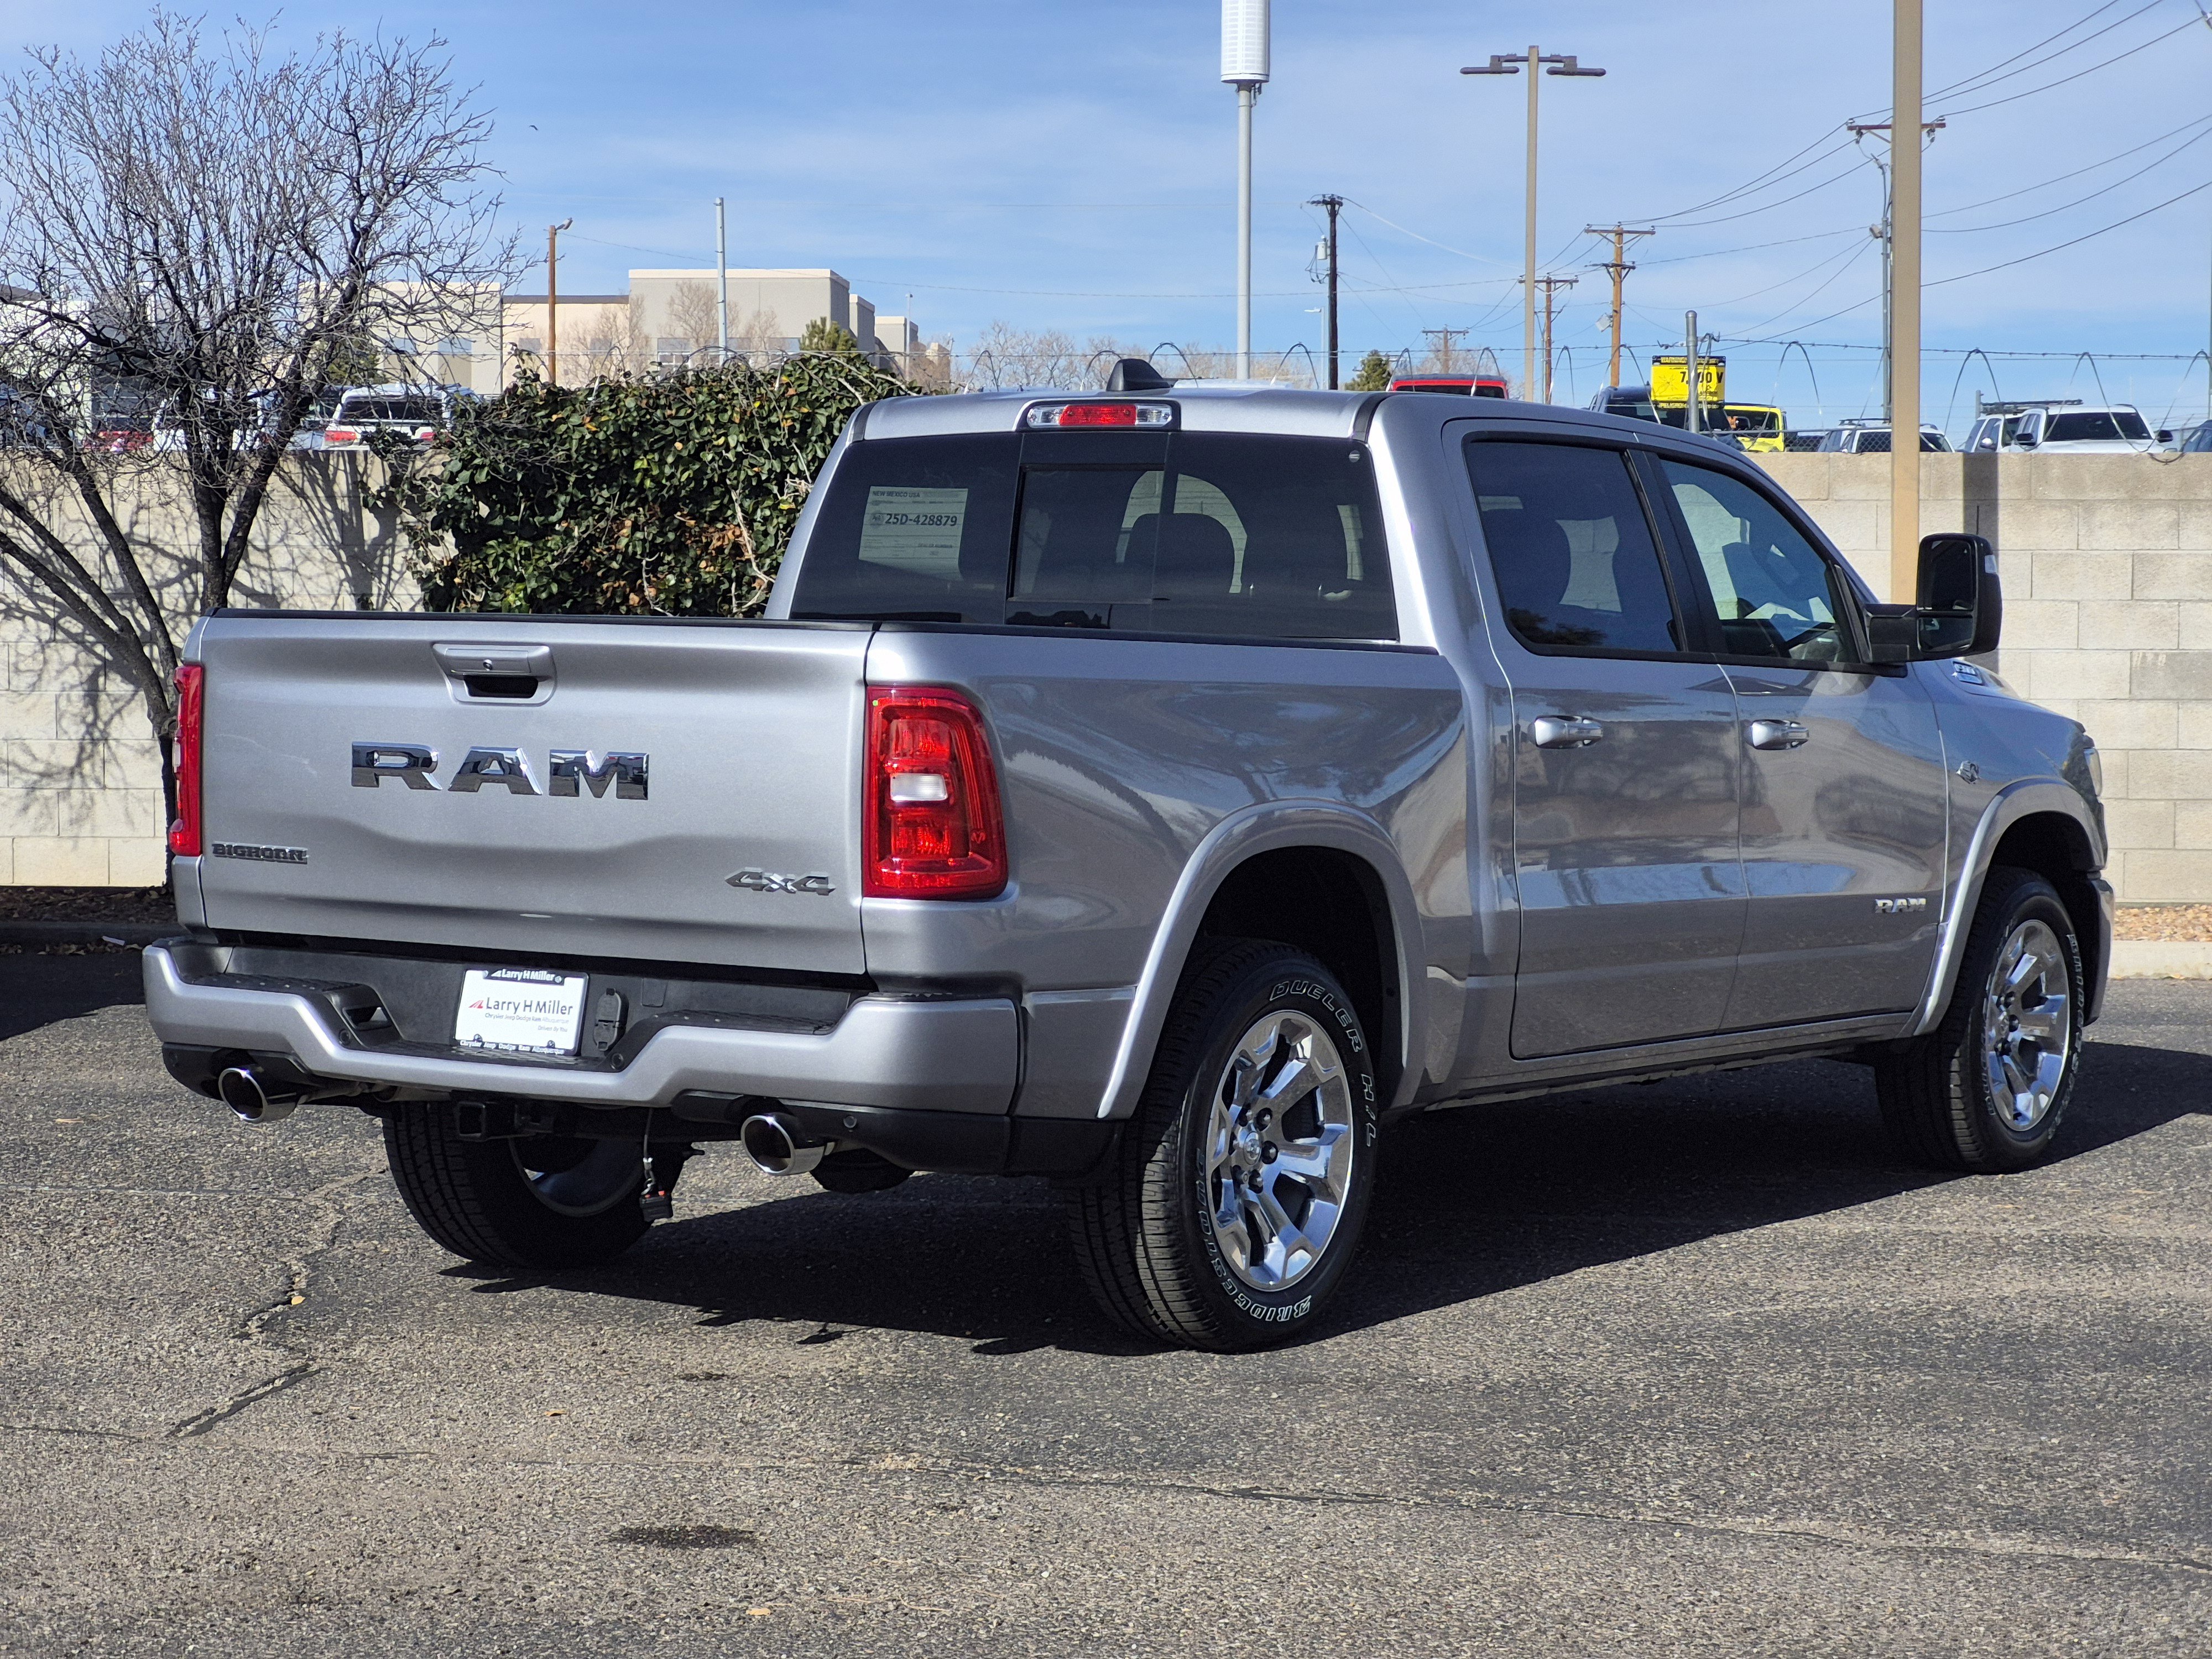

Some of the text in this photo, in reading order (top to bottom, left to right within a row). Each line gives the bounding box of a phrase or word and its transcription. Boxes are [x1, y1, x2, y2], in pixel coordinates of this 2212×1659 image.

[885, 513, 958, 526] 25D-428879
[352, 741, 649, 801] RAM
[1875, 898, 1927, 914] RAM
[502, 969, 555, 981] Larry H Miller
[486, 997, 573, 1015] Larry H Miller
[1269, 980, 1363, 1053] DUELER
[1196, 1148, 1312, 1322] BRIDGESTONE
